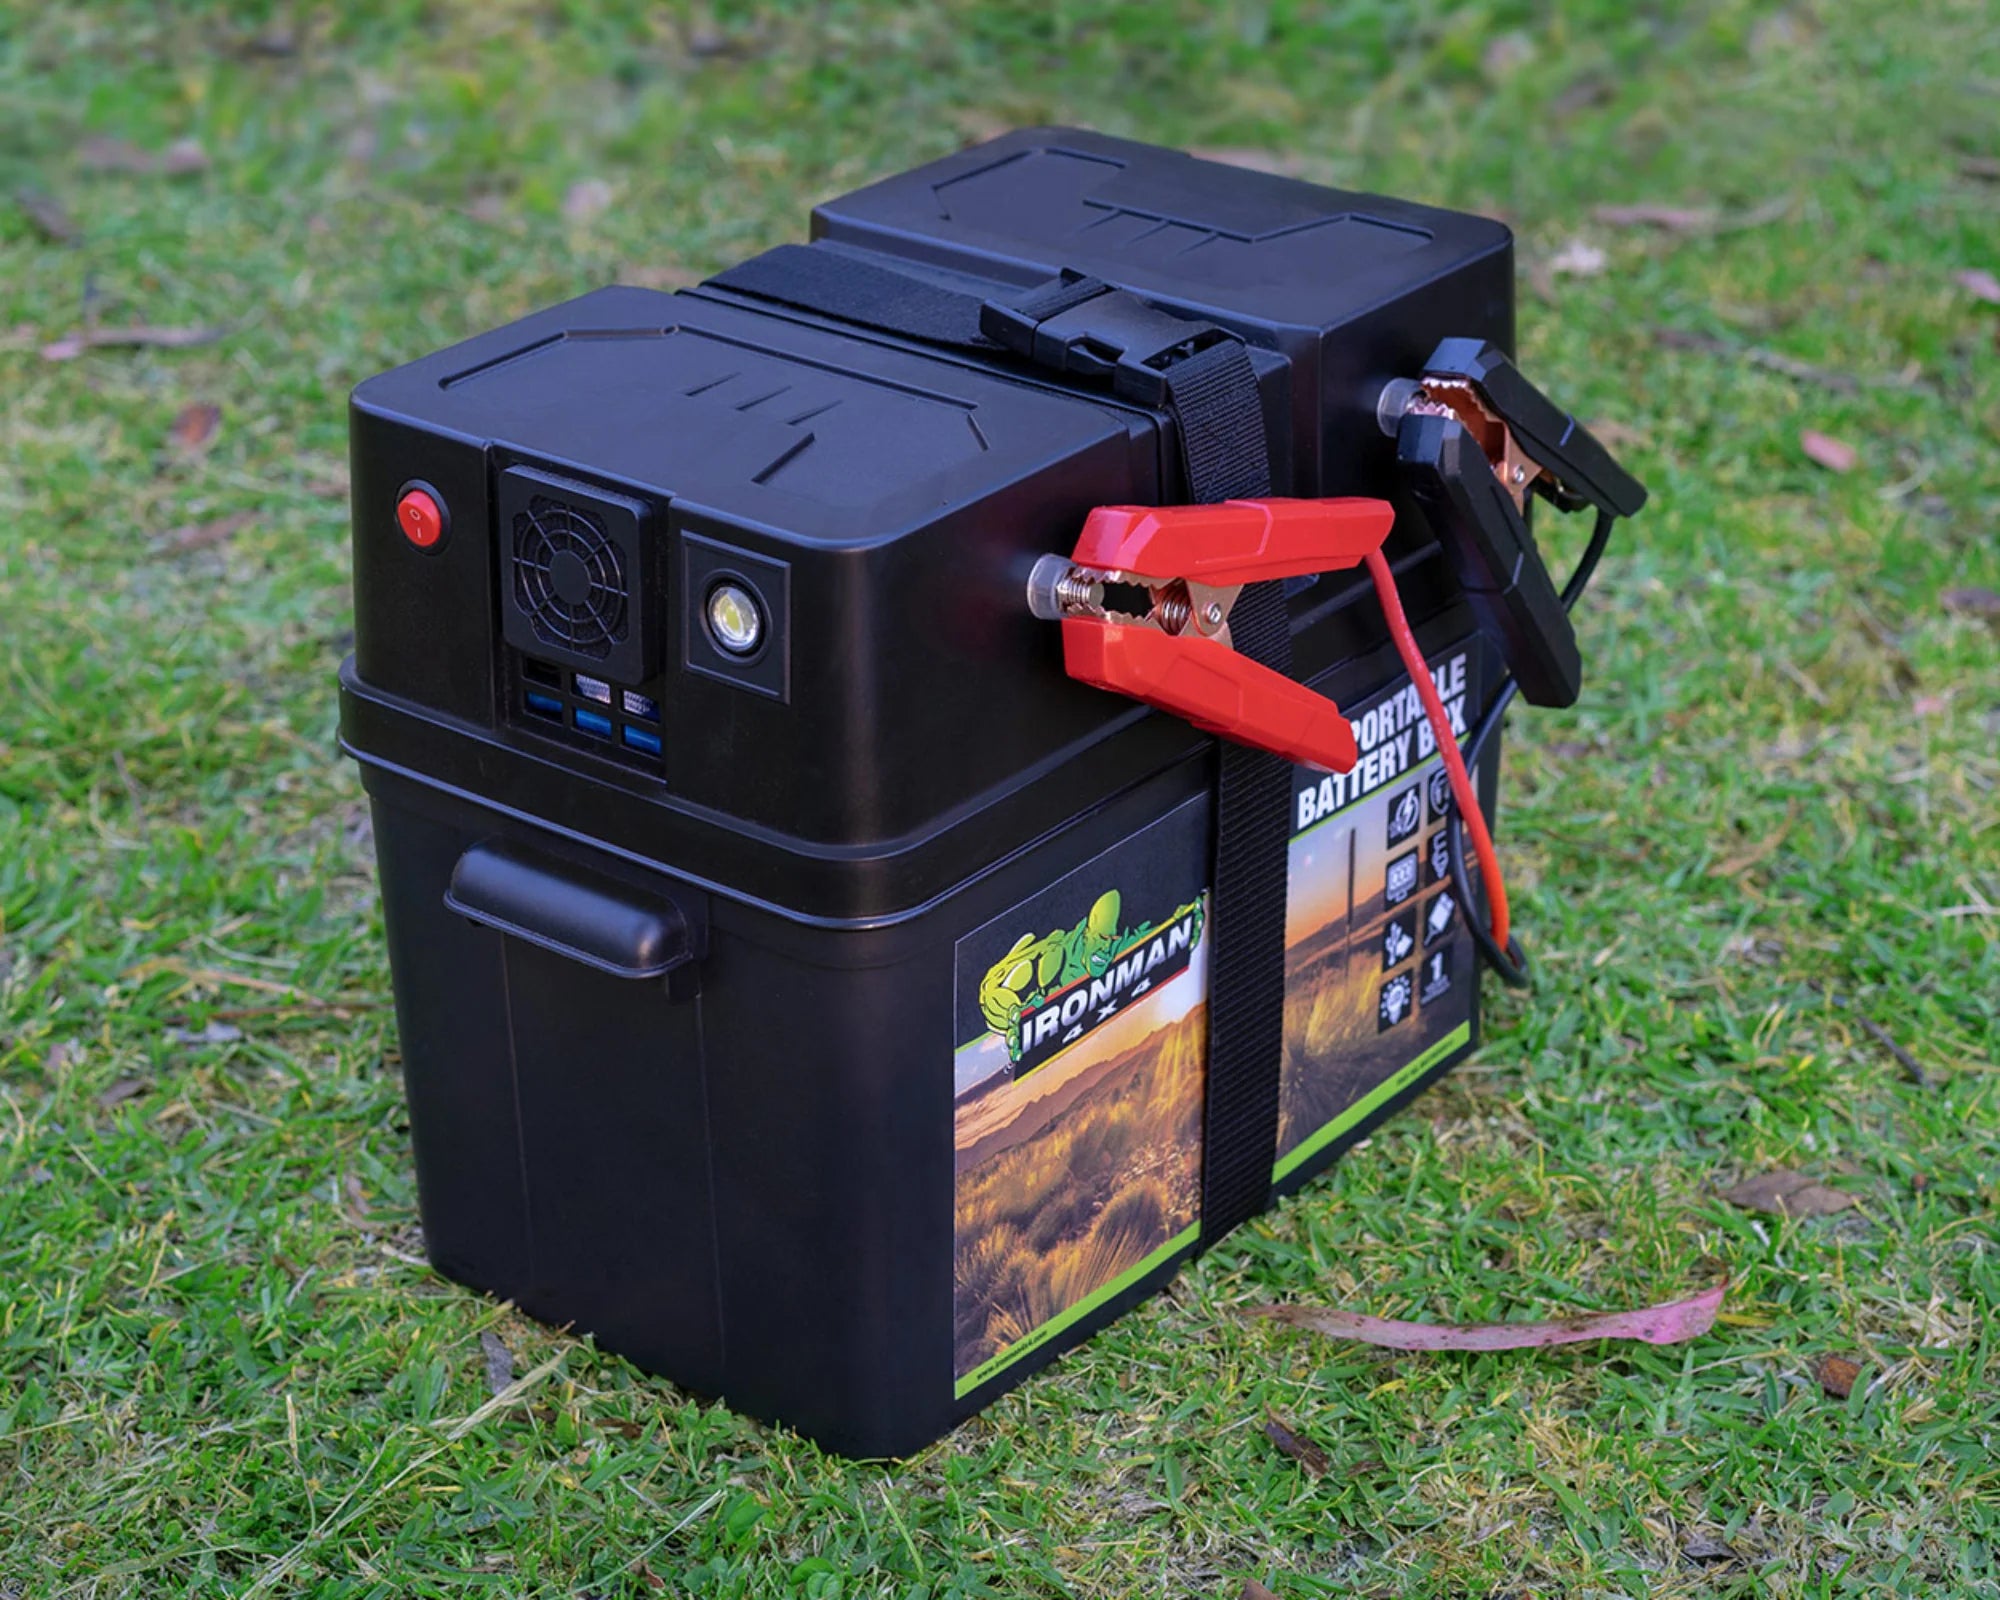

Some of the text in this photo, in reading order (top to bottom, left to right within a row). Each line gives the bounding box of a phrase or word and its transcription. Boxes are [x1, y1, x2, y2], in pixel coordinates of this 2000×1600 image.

[1297, 694, 1466, 830] BATTERY BX
[1351, 653, 1466, 752] ORTALE
[1022, 916, 1192, 1053] IRONMAN
